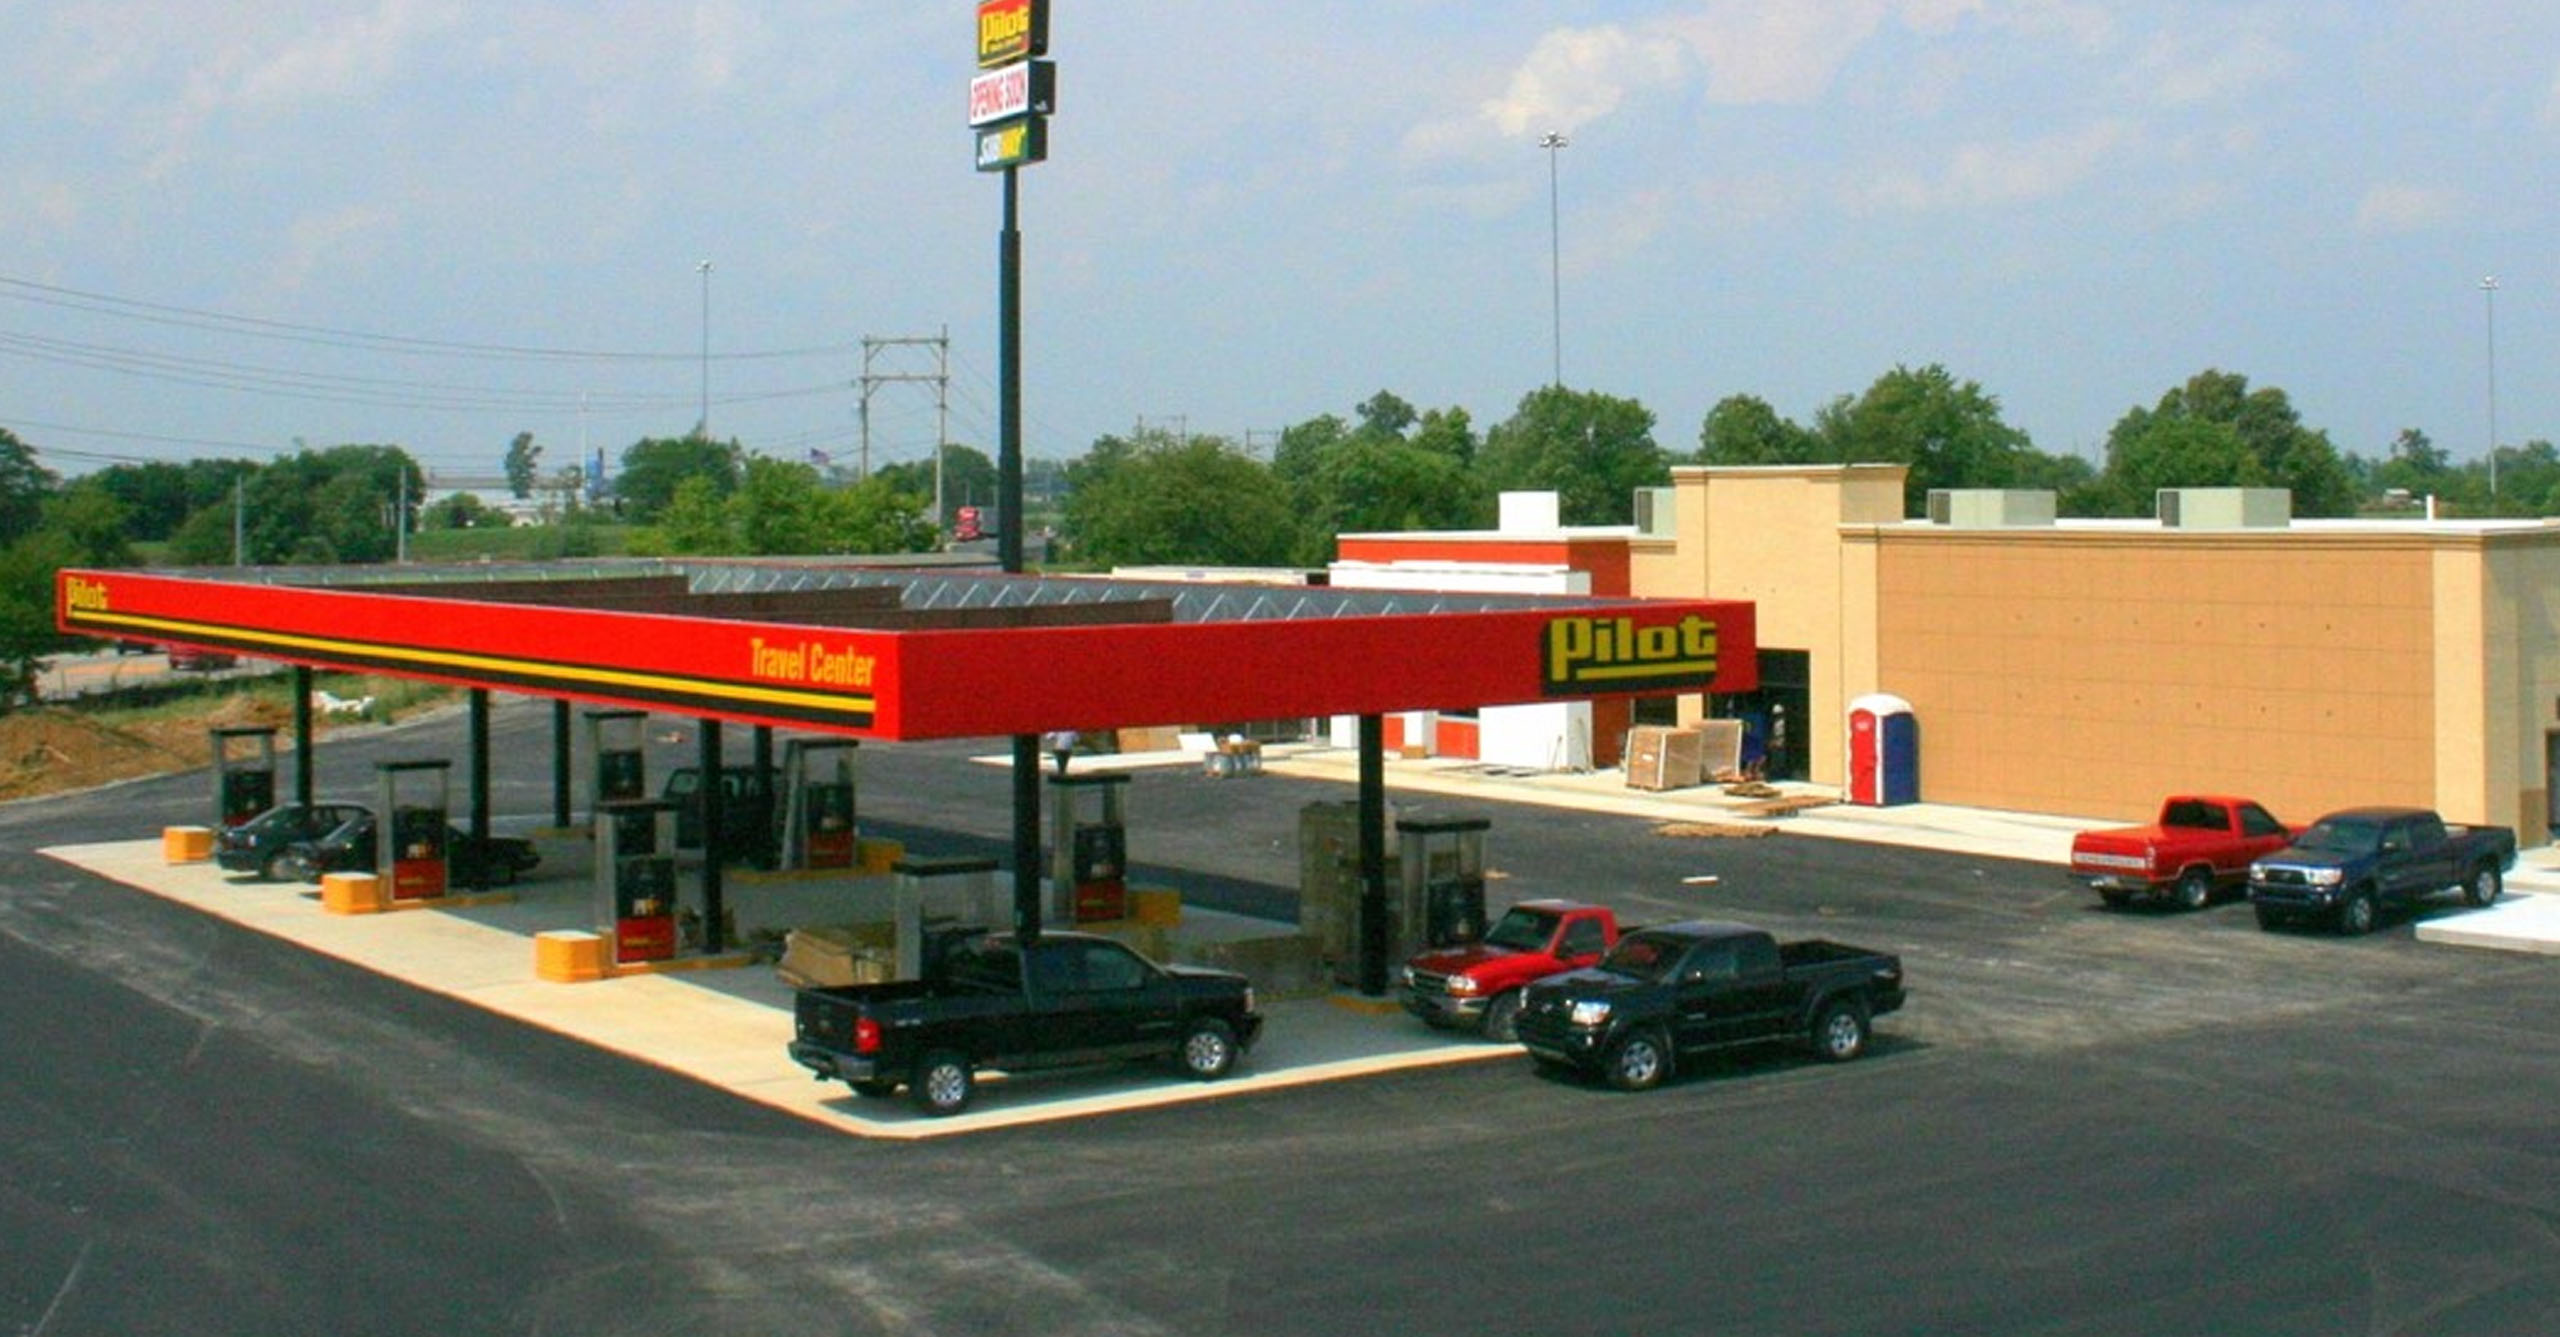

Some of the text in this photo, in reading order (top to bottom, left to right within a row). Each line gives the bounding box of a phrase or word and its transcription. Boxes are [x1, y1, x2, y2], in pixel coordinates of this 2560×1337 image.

[981, 7, 1029, 54] Pilot
[66, 577, 108, 617] Pilot
[751, 638, 875, 686] Travel Center
[1551, 616, 1717, 681] Pilot
